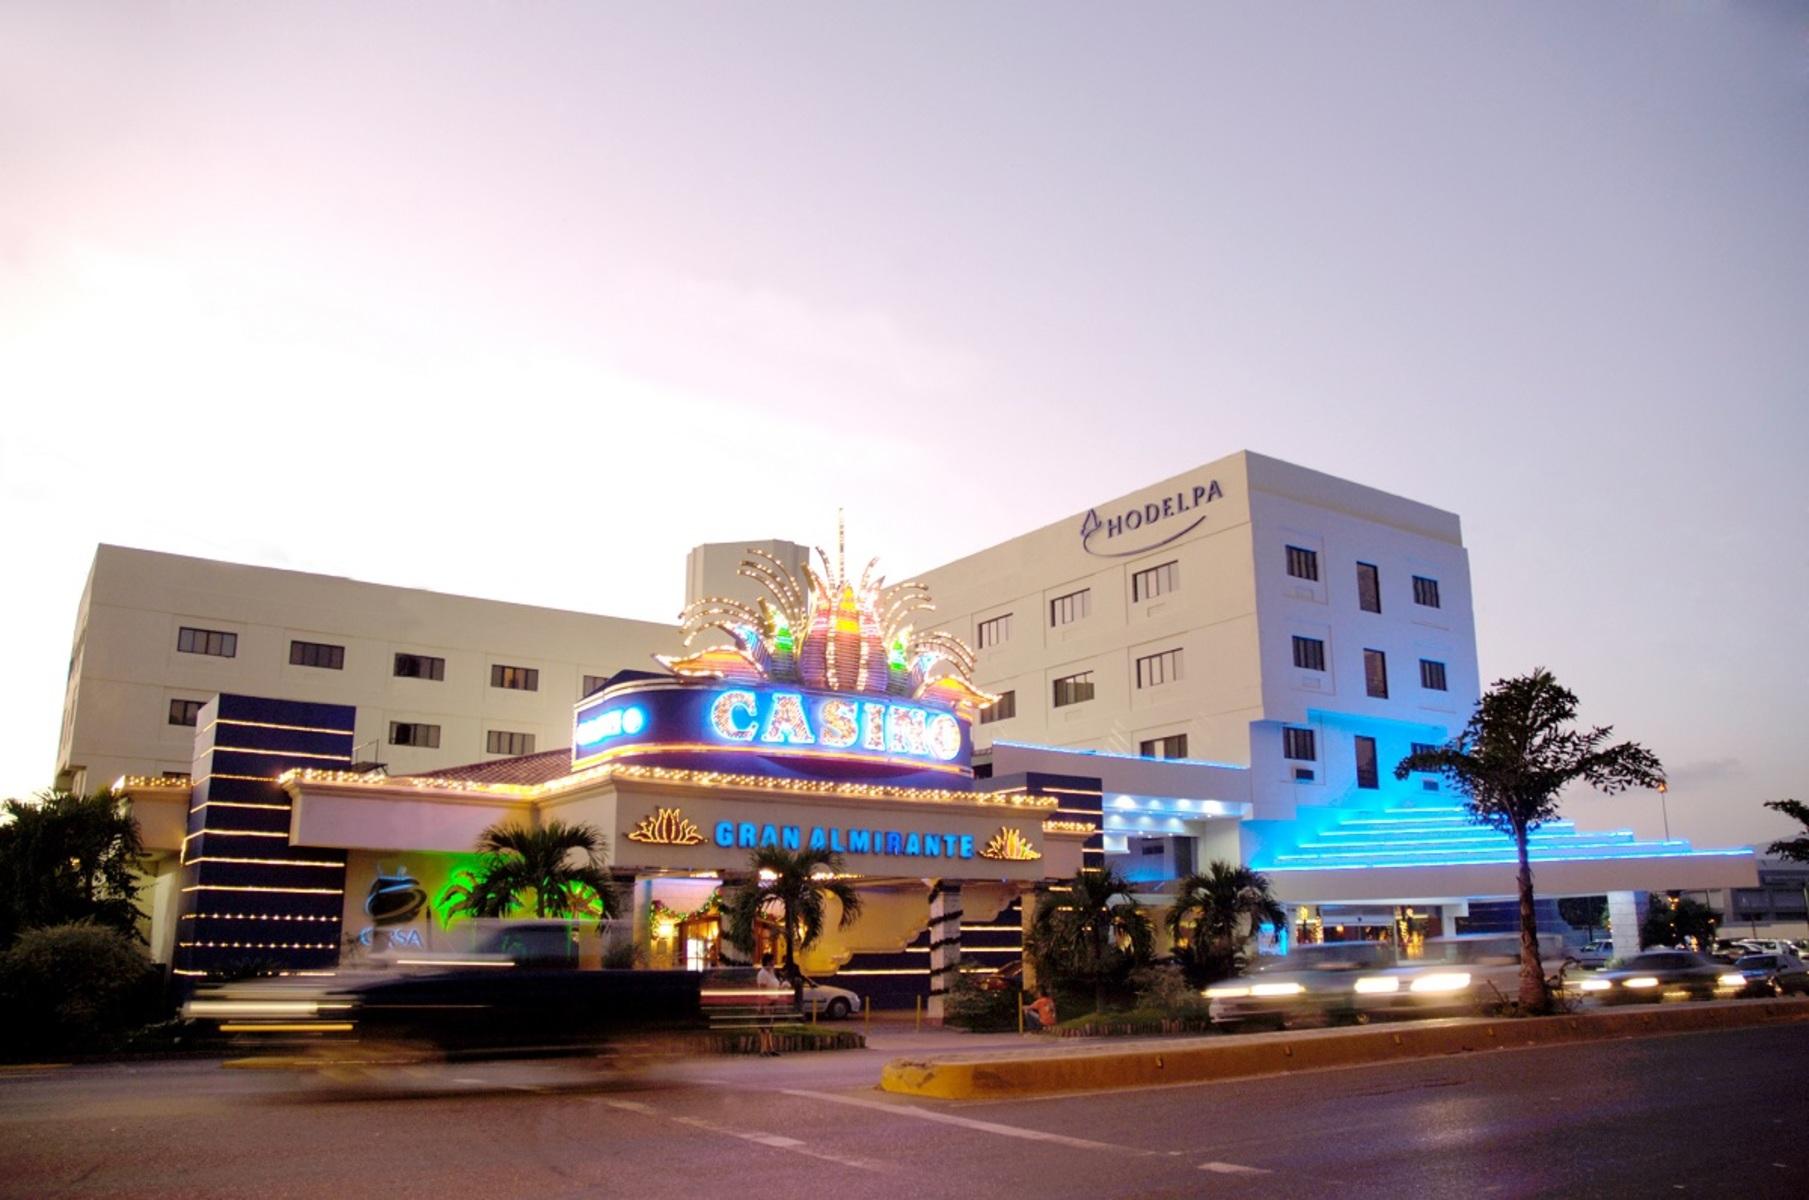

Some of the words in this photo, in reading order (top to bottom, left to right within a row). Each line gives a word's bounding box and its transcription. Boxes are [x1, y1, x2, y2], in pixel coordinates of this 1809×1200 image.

[1107, 480, 1223, 538] HODELPA
[710, 690, 961, 760] CASINO
[714, 820, 800, 850] GRAN
[809, 826, 975, 859] ALMIRANTE
